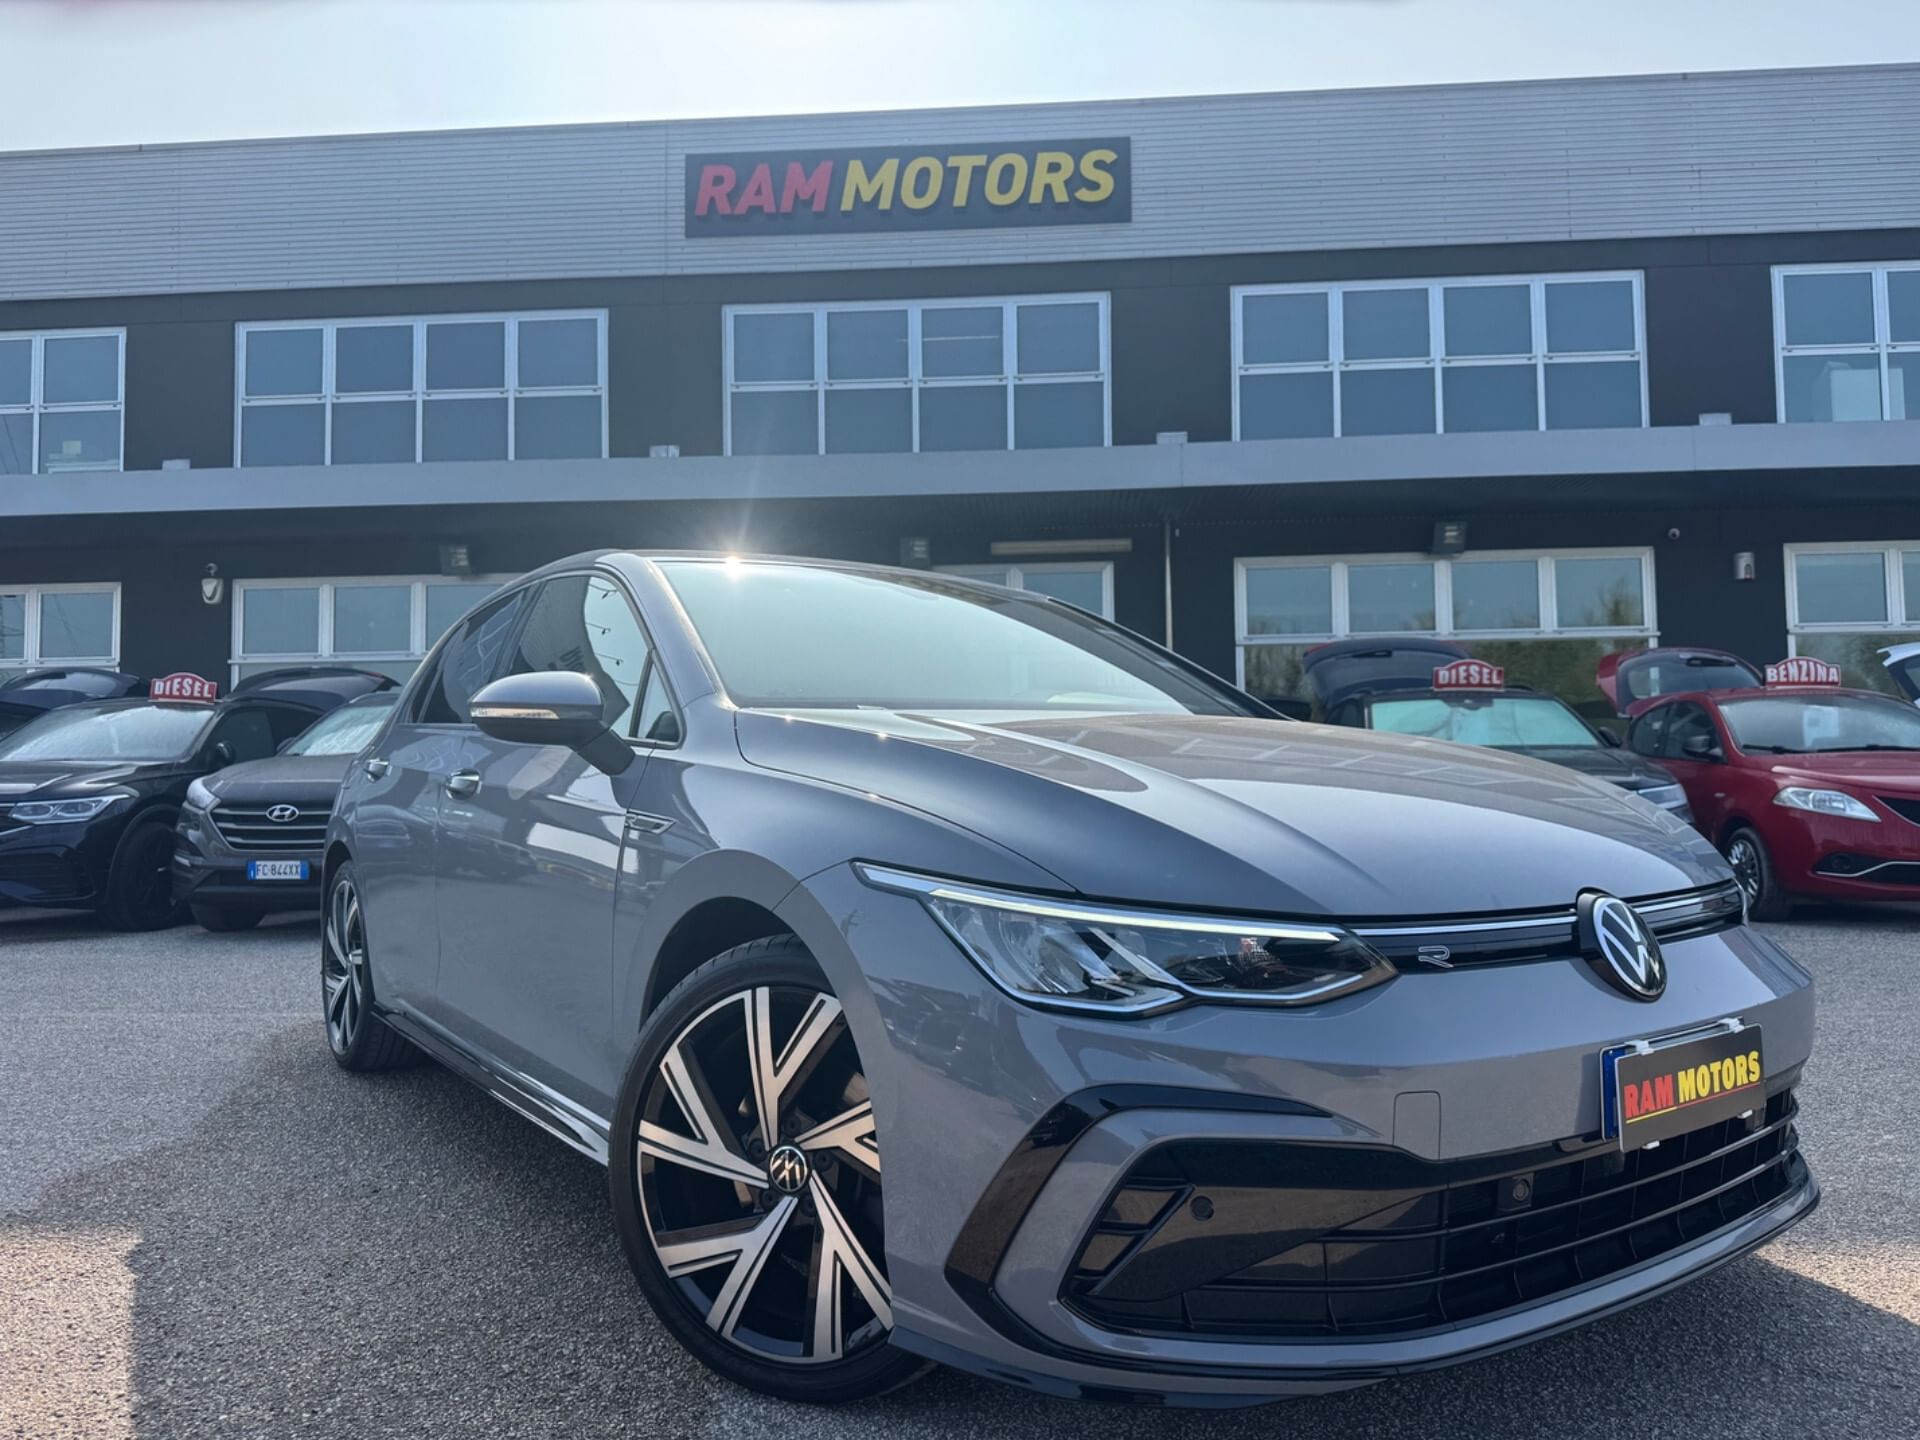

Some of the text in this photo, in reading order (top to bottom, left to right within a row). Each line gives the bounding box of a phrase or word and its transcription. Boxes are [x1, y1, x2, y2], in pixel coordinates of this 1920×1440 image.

[694, 149, 1118, 215] RAM MOTORS
[1438, 664, 1502, 684] DIESEL
[1766, 659, 1839, 683] BENZINA
[154, 677, 212, 697] DIESEL
[1623, 1050, 1761, 1118] RAM MOTORS
